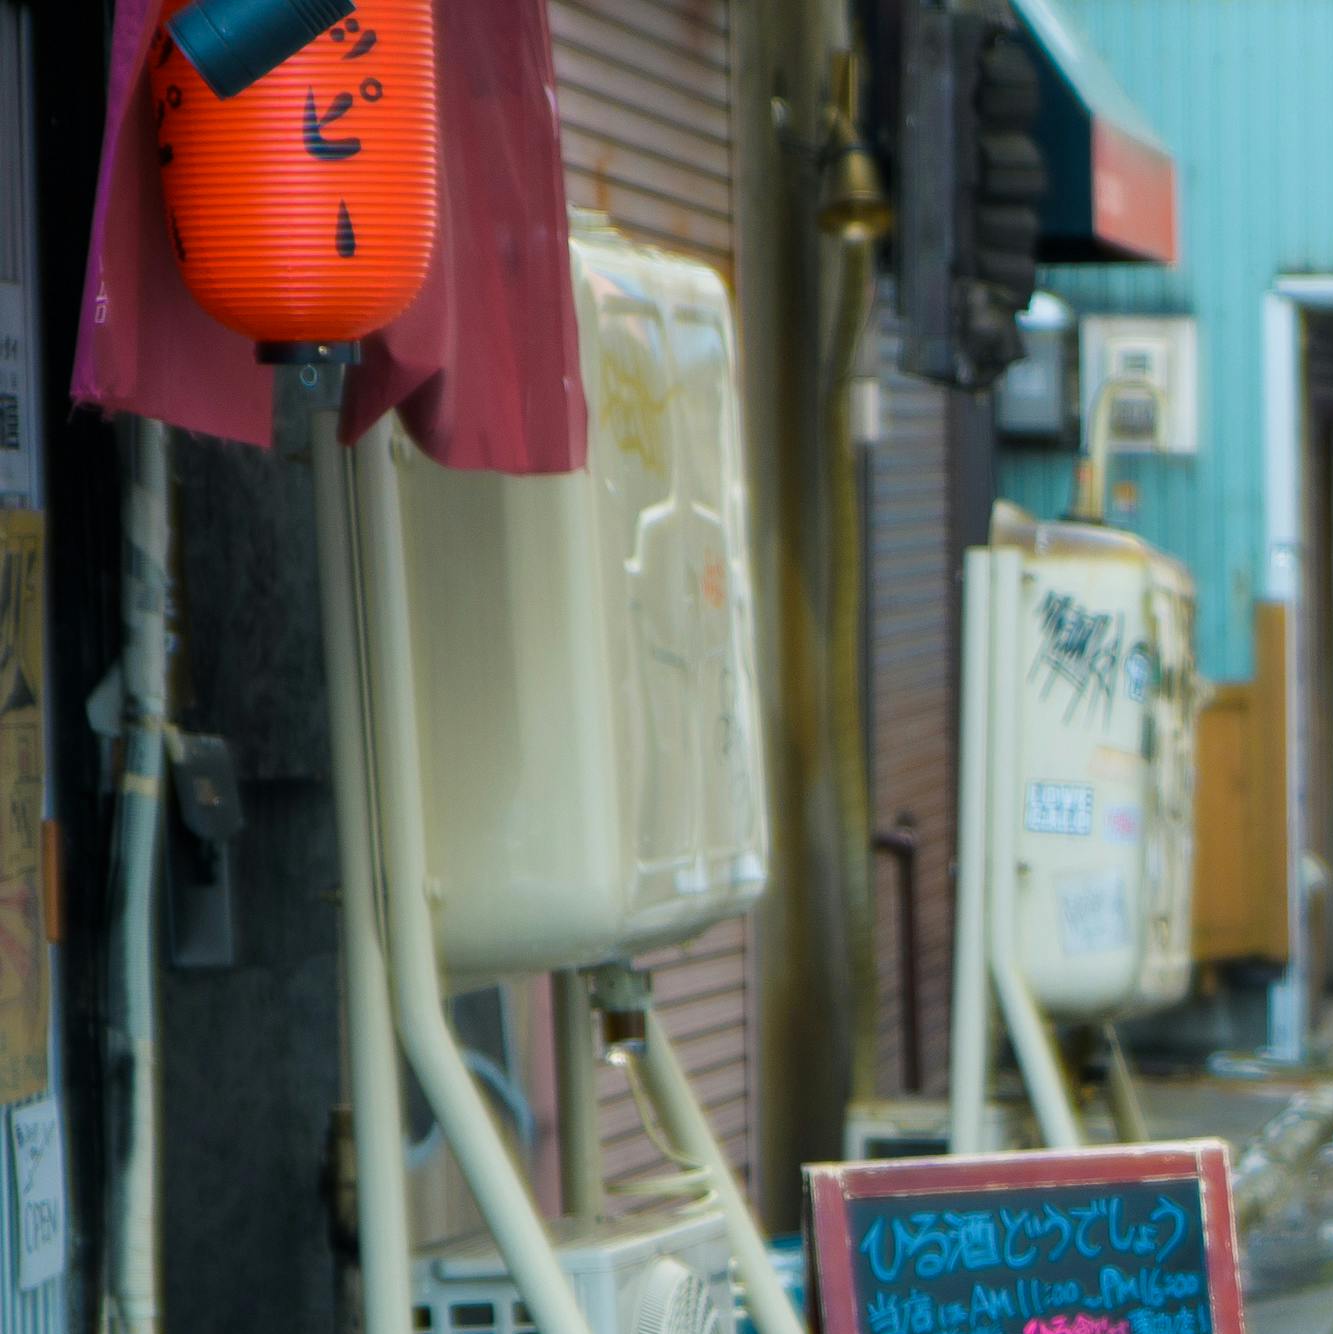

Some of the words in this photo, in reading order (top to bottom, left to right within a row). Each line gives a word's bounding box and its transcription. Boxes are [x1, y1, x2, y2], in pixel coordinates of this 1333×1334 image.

[859, 1193, 1190, 1284] ひる酒どうでしょう
